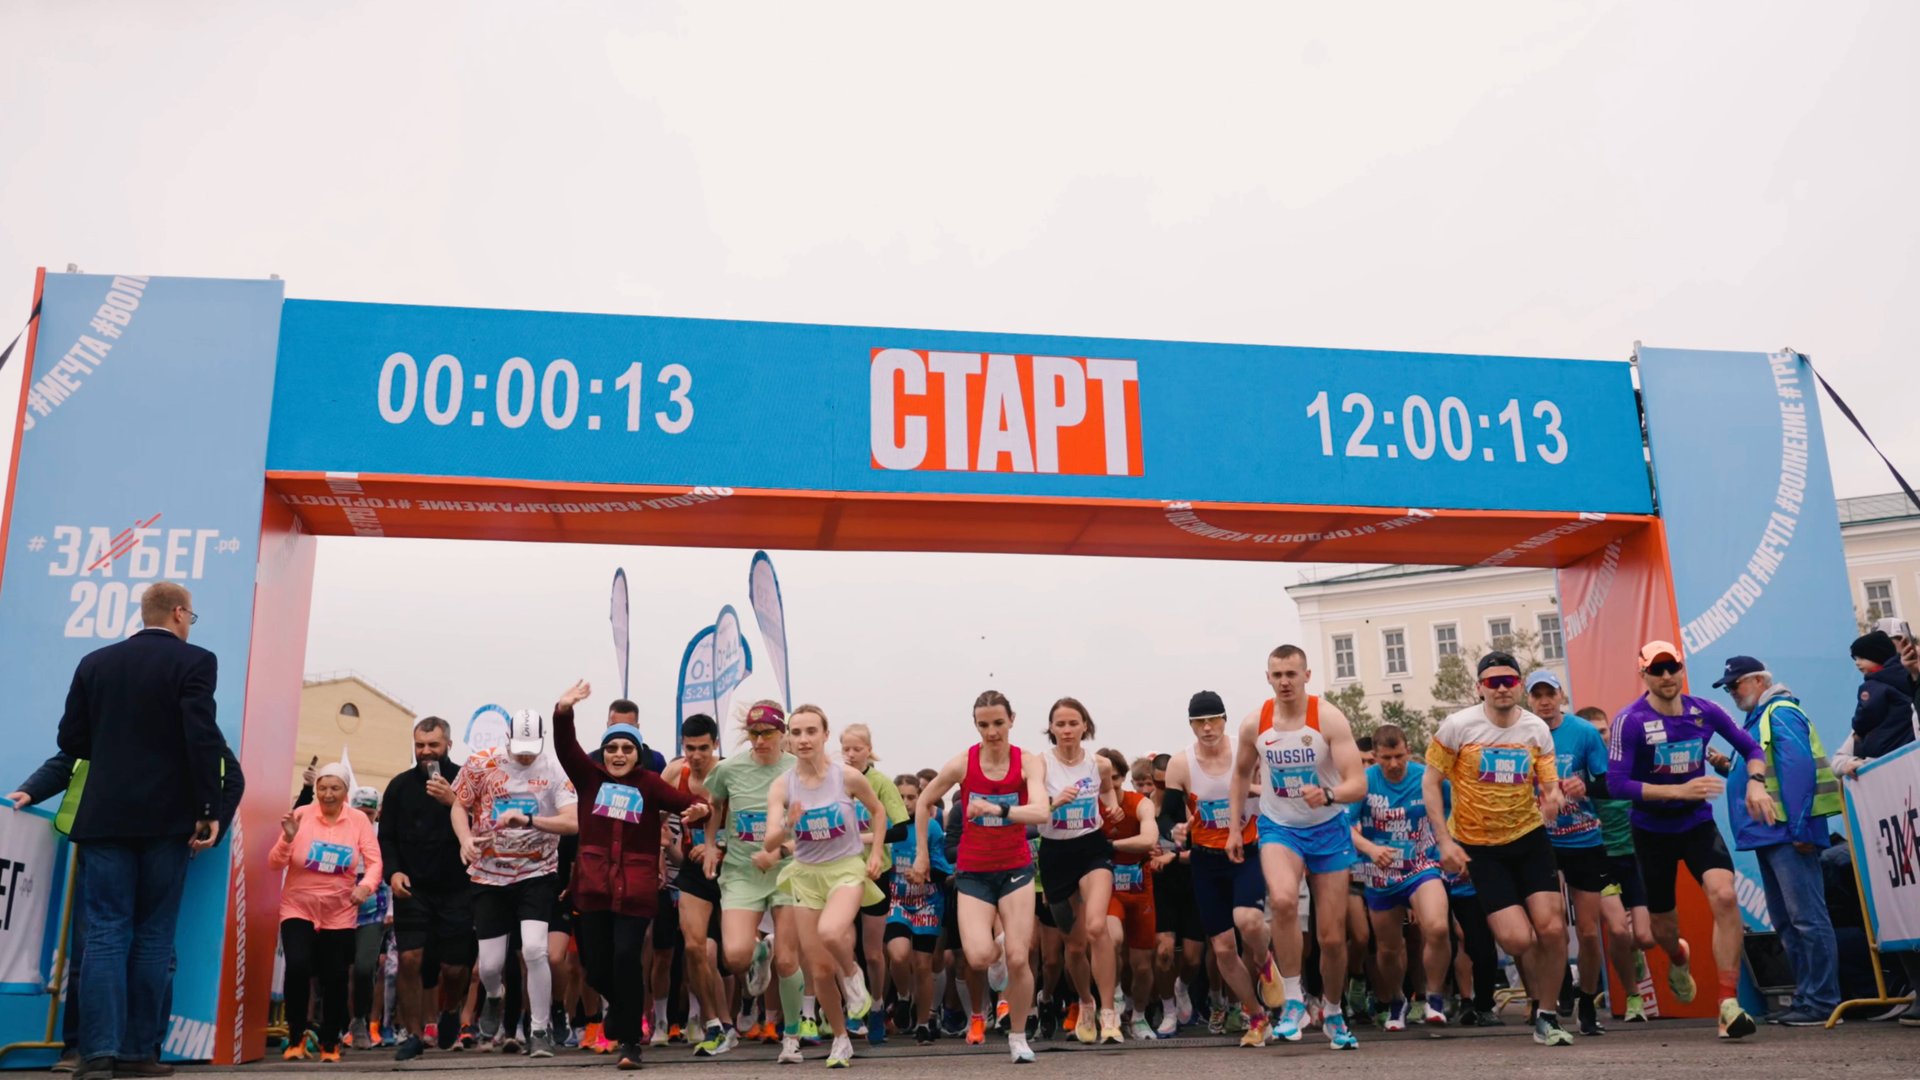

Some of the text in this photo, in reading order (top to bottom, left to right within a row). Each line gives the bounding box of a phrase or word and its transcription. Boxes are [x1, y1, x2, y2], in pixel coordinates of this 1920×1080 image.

[27, 334, 113, 417] #МЕЧТА
[379, 353, 693, 433] 00:00:13
[871, 349, 1137, 475] СТАРТ
[1308, 392, 1567, 463] 12:00:13
[417, 499, 642, 514] #САМОВЫРАЖЕНИЕ
[1747, 511, 1797, 585] #МЕЧТА
[1776, 401, 1809, 516] #ВОЛНЕНИЕ
[1253, 524, 1376, 543] #ГОРДОСТЬ
[1266, 748, 1315, 765] RUSSIA
[235, 868, 246, 1002] #СВОБОДА
